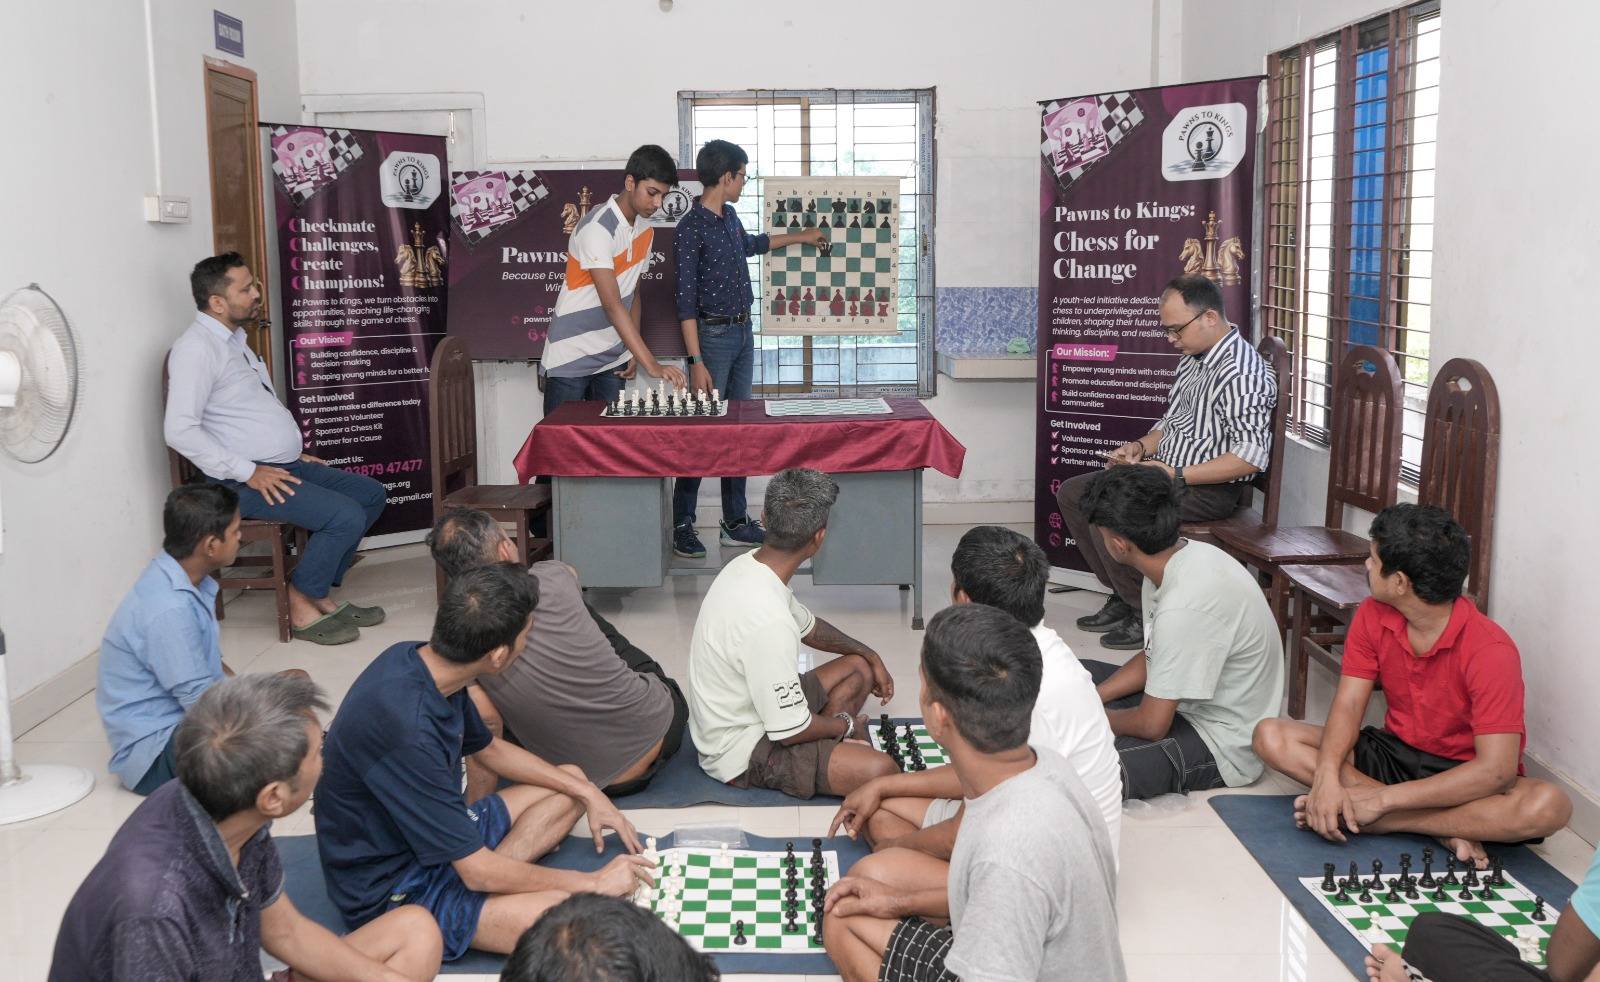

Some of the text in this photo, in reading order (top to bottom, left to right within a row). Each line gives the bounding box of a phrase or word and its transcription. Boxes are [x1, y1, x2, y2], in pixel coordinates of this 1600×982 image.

[1179, 114, 1199, 140] PAWNS
[1215, 113, 1233, 137] KINGS
[393, 158, 405, 176] PAWNS
[682, 186, 694, 201] KING
[1054, 202, 1195, 222] Pawns to Kings:
[289, 218, 375, 232] Checkmate
[290, 237, 379, 254] Challenges,
[1054, 229, 1160, 252] Chess for
[501, 247, 568, 263] Pawns
[291, 257, 343, 270] Create
[502, 271, 565, 280] Because Eve
[1053, 258, 1136, 284] Change
[292, 274, 384, 292] Champions!
[340, 297, 362, 306] Kings,
[1060, 296, 1095, 305] youth-led
[292, 306, 430, 318] opportunities, teaching life-changing
[1084, 307, 1143, 317] underprivileged
[294, 320, 312, 328] skills
[315, 318, 345, 328] through
[346, 317, 359, 325] the
[1052, 318, 1082, 326] children,
[1084, 318, 1114, 327] shaping
[1134, 318, 1158, 326] future
[1052, 328, 1082, 338] thinking,
[1084, 329, 1120, 338] discipline,
[300, 336, 345, 345] Our Vision:
[310, 351, 338, 360] Building
[380, 347, 411, 356] discipline
[1056, 348, 1109, 358] Our Mission:
[311, 358, 371, 368] decision-making
[312, 372, 341, 382] Shaping
[342, 371, 365, 380] young
[366, 369, 387, 377] minds
[387, 367, 397, 375] for
[1062, 365, 1176, 376] Empower young minds with critica
[1139, 381, 1172, 390] discipline
[299, 392, 354, 404] Get Involved
[402, 398, 421, 406] today
[1078, 391, 1114, 399] confidence
[1130, 394, 1167, 404] leadership
[315, 417, 343, 425] Become
[350, 412, 384, 422] Volunteer
[315, 427, 343, 437] Sponsor
[350, 424, 372, 432] Chess
[1065, 421, 1101, 431] Involved
[316, 438, 341, 447] Partner
[359, 434, 382, 442] Cause
[1062, 435, 1093, 444] Volunteer
[1062, 446, 1088, 455] Sponsor
[386, 459, 422, 473] 47477
[1086, 459, 1100, 467] with
[381, 481, 410, 490] ngs.org
[386, 492, 432, 504] o@gmail.co
[772, 680, 804, 709] 23
